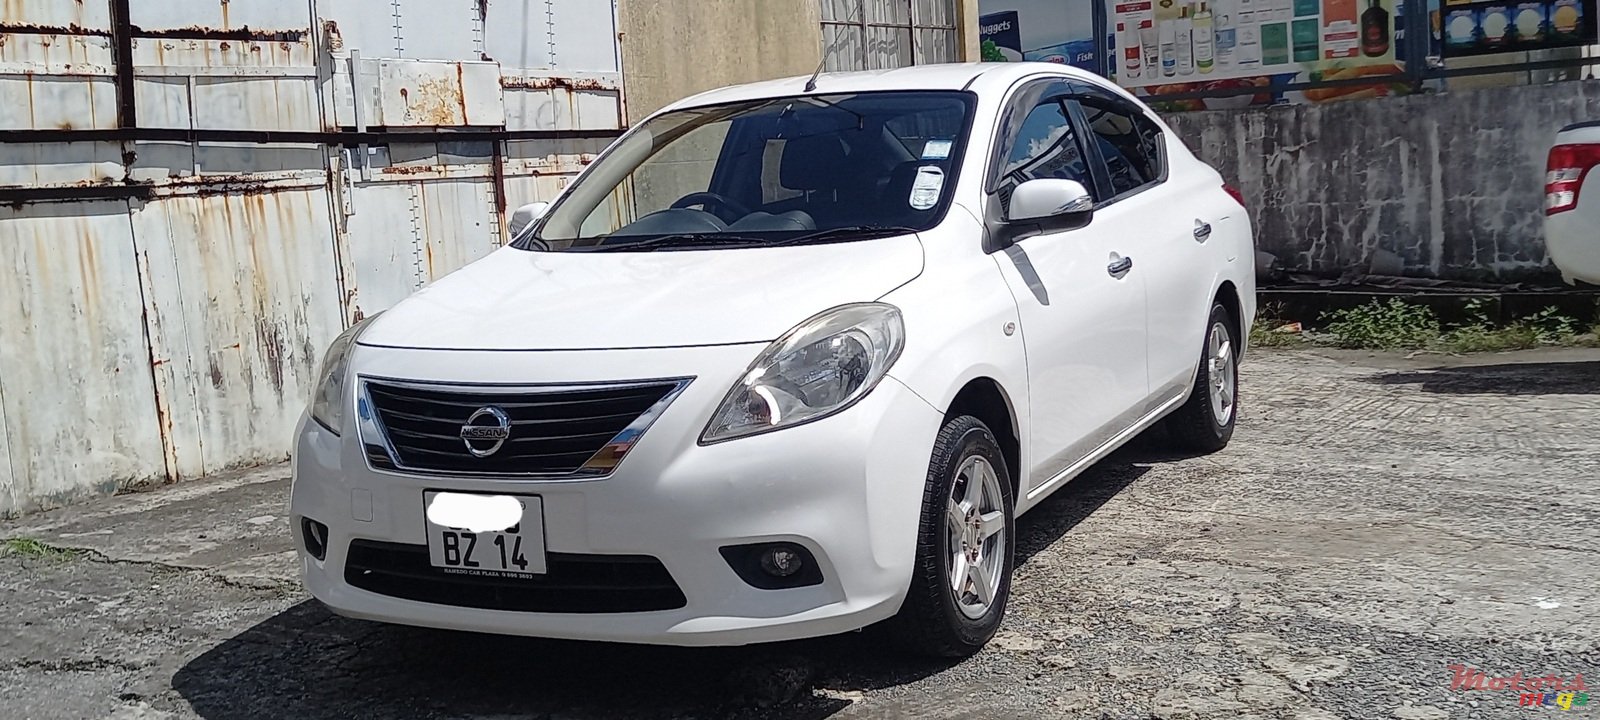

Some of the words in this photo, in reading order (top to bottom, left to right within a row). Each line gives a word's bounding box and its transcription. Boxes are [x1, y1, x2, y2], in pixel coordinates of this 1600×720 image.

[1076, 52, 1094, 63] Fish
[462, 428, 502, 437] NISSAN
[442, 531, 480, 568] BZ
[494, 534, 529, 571] 14
